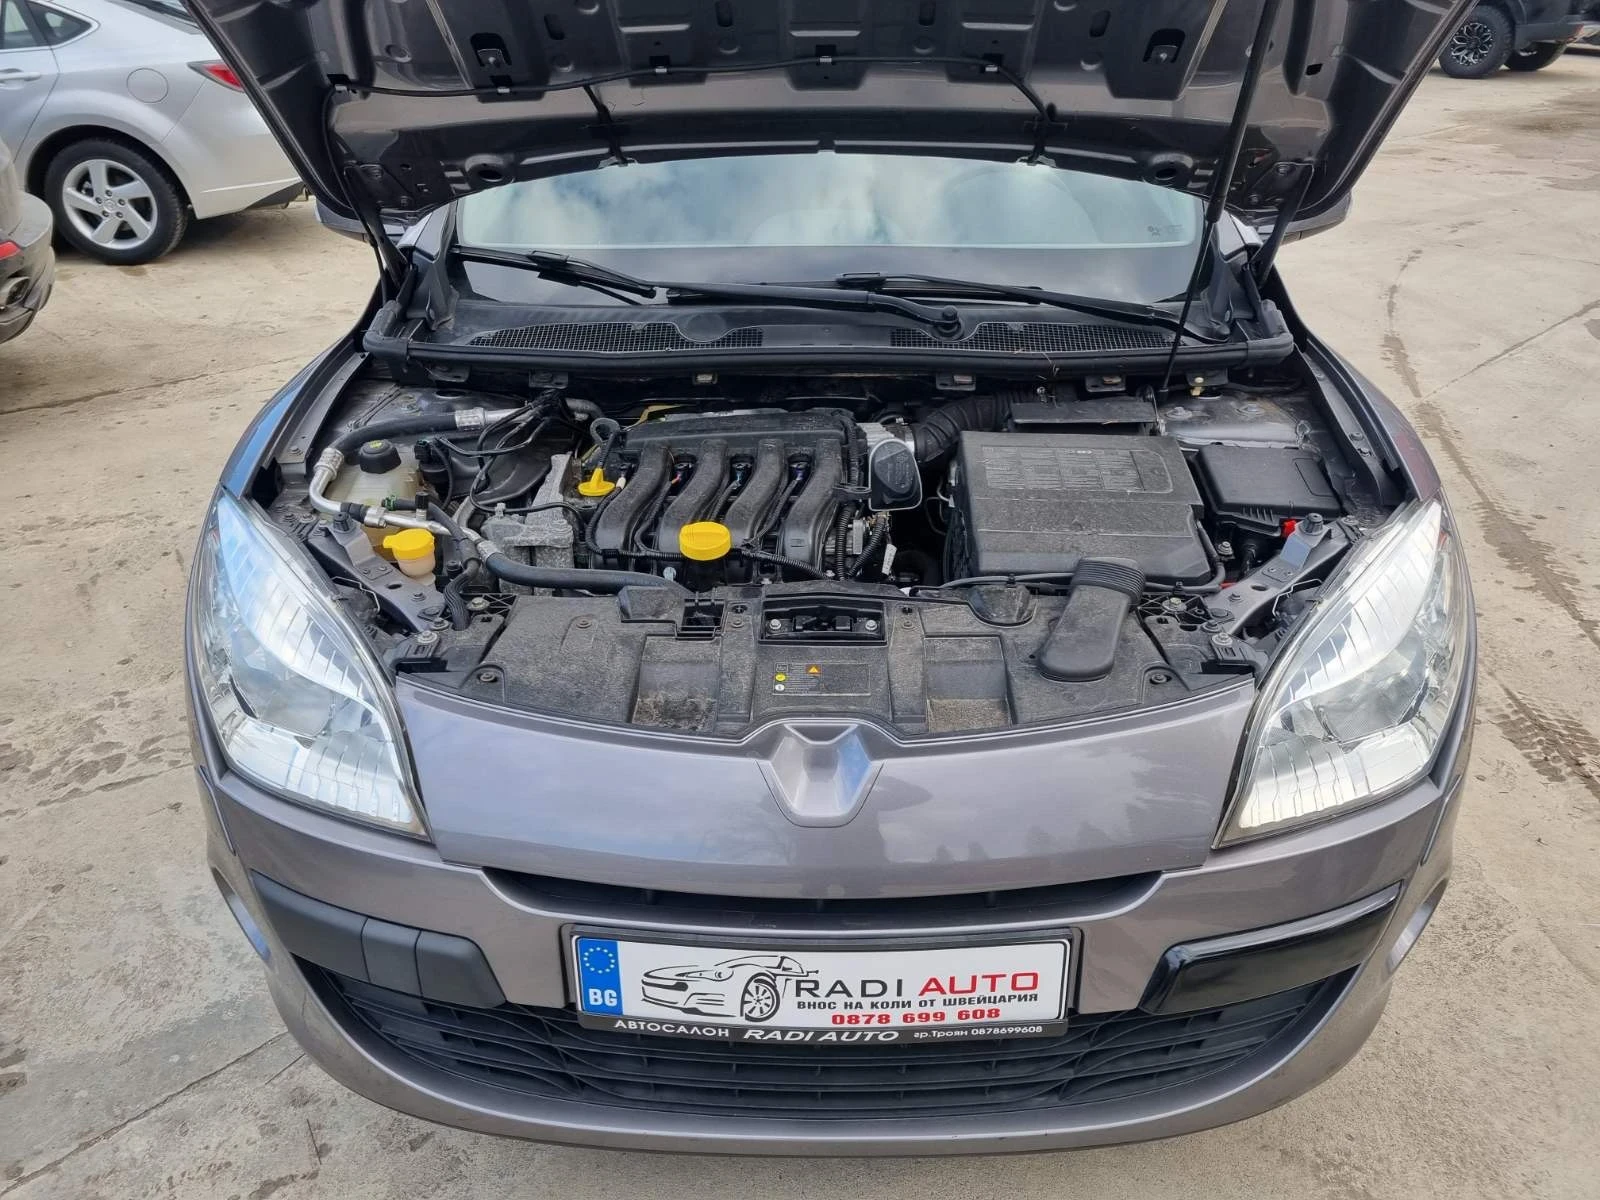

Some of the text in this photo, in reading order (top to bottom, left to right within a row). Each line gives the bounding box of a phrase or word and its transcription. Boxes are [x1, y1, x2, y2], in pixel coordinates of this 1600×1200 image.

[796, 972, 1039, 998] RADI AUTO
[588, 988, 618, 1007] BG
[797, 993, 1039, 1010] ВНОС НА КОЛИ ОТ ШВЕЙЦАРИЯ
[831, 1008, 1001, 1025] 0878 699 608
[614, 1019, 729, 1038] АВТОСАЛОН
[744, 1029, 900, 1041] RADI AUTO
[971, 1025, 1043, 1036] 0878699608
